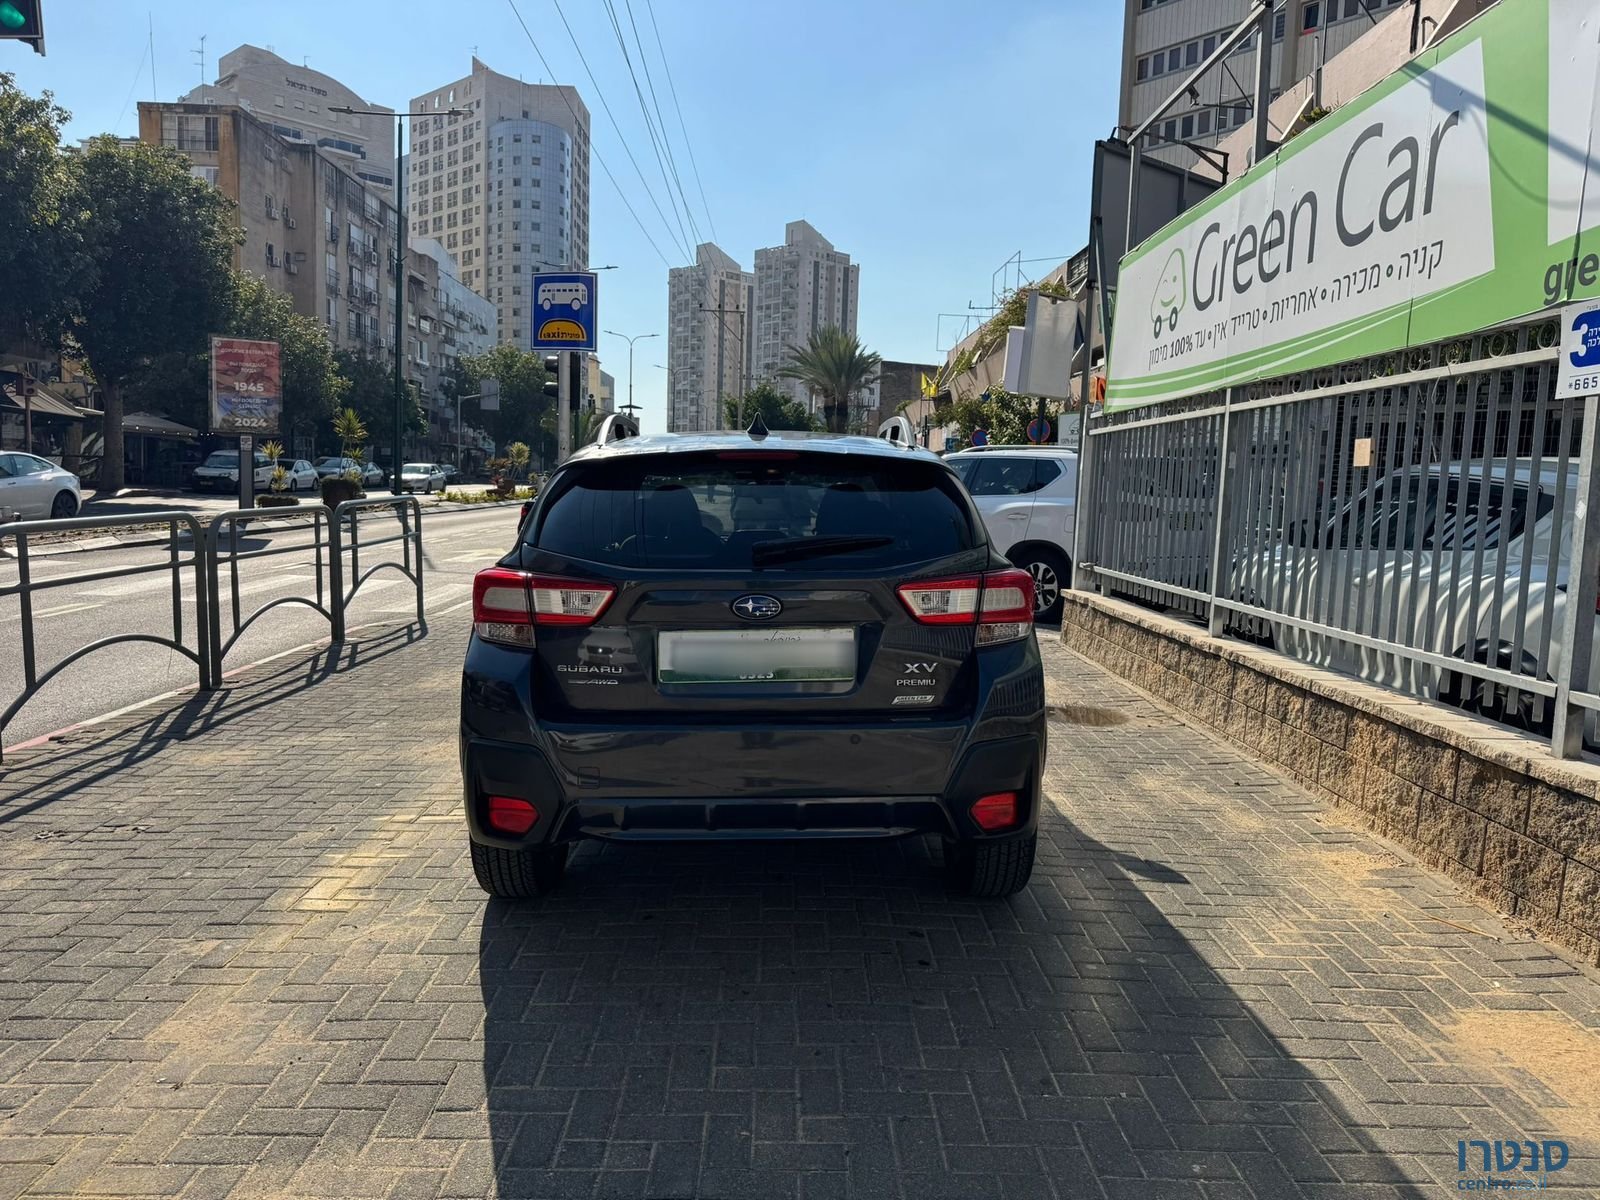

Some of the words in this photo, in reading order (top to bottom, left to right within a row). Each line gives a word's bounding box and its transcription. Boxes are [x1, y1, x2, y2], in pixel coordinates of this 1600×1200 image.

[1193, 190, 1318, 312] Green
[1335, 110, 1460, 248] Car
[1398, 240, 1444, 281] קניה
[1331, 263, 1381, 303] מכירה
[1269, 286, 1319, 324] אחריות
[543, 327, 560, 339] taxi
[1213, 320, 1228, 349] אין
[1231, 308, 1260, 336] טרייד
[1170, 333, 1193, 359] 100%
[1195, 328, 1207, 350] עד
[1148, 344, 1168, 372] מימון
[233, 381, 264, 392] 1945
[234, 418, 267, 427] 2024
[557, 664, 622, 674] SUBARU
[904, 662, 939, 674] XV
